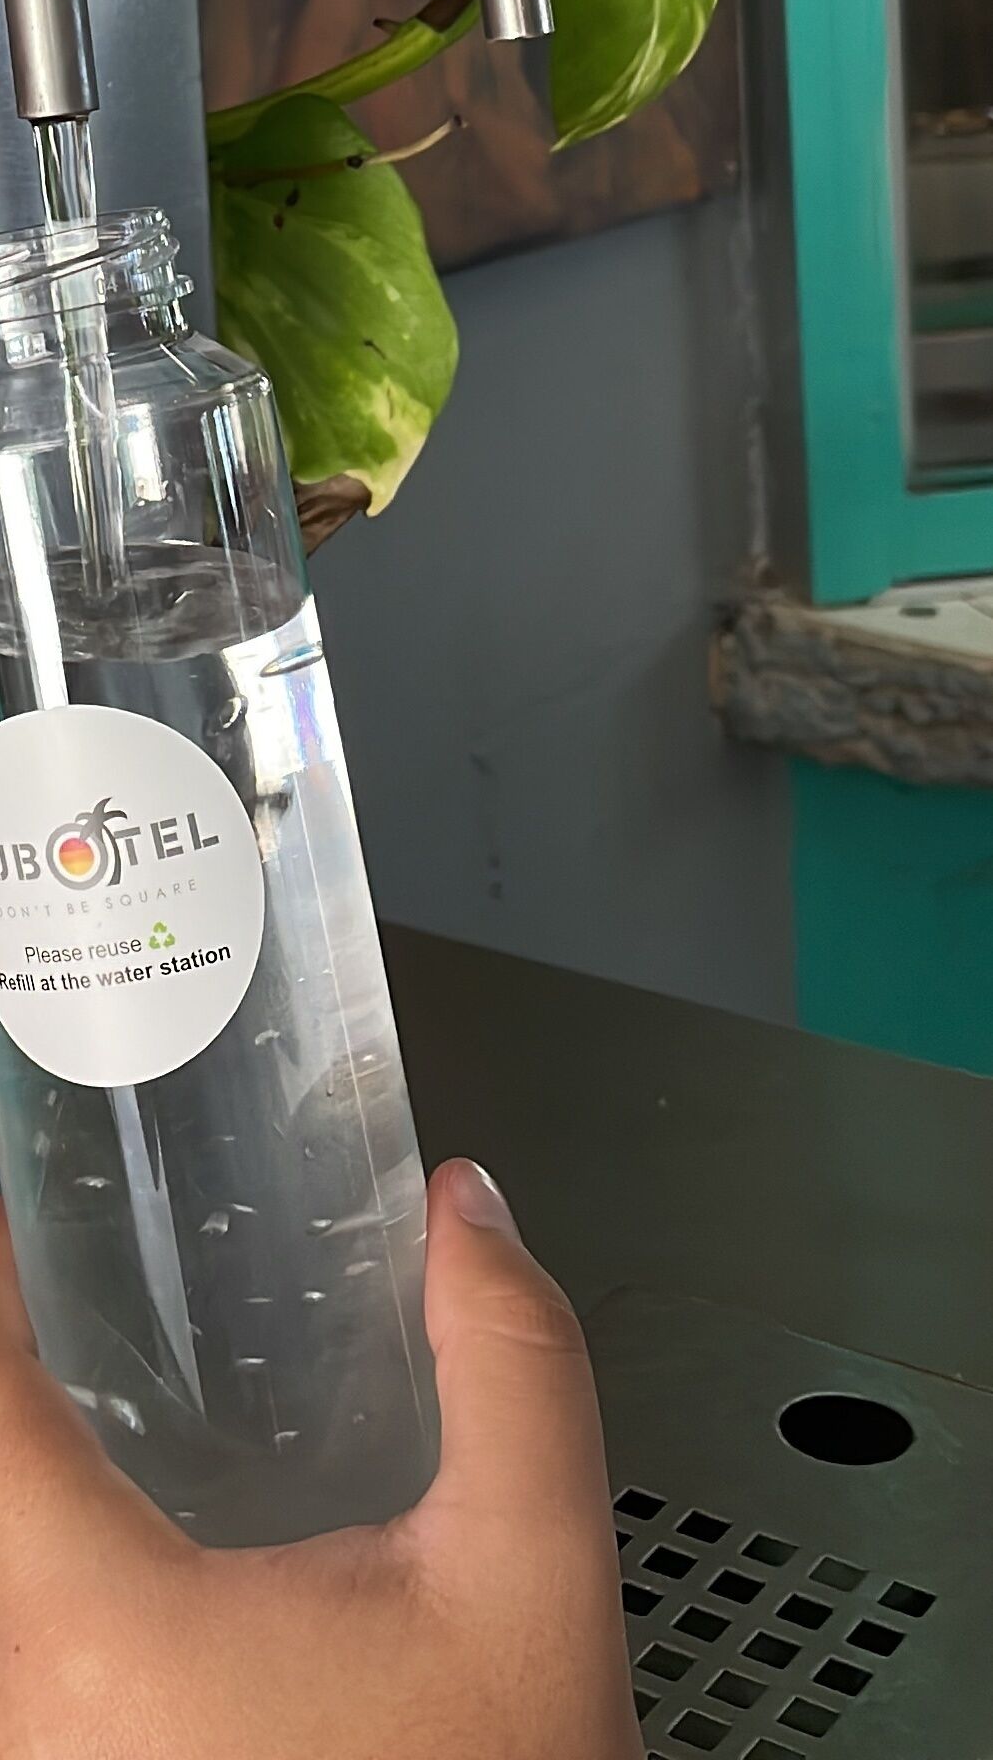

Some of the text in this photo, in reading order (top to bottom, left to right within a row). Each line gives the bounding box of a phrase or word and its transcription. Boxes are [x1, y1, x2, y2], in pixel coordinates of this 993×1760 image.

[66, 900, 91, 915] BE
[105, 878, 198, 910] SQUARE
[24, 938, 142, 964] Please reuse
[40, 974, 57, 991] at
[61, 971, 91, 990] the
[96, 964, 153, 987] water
[159, 946, 231, 976] station
